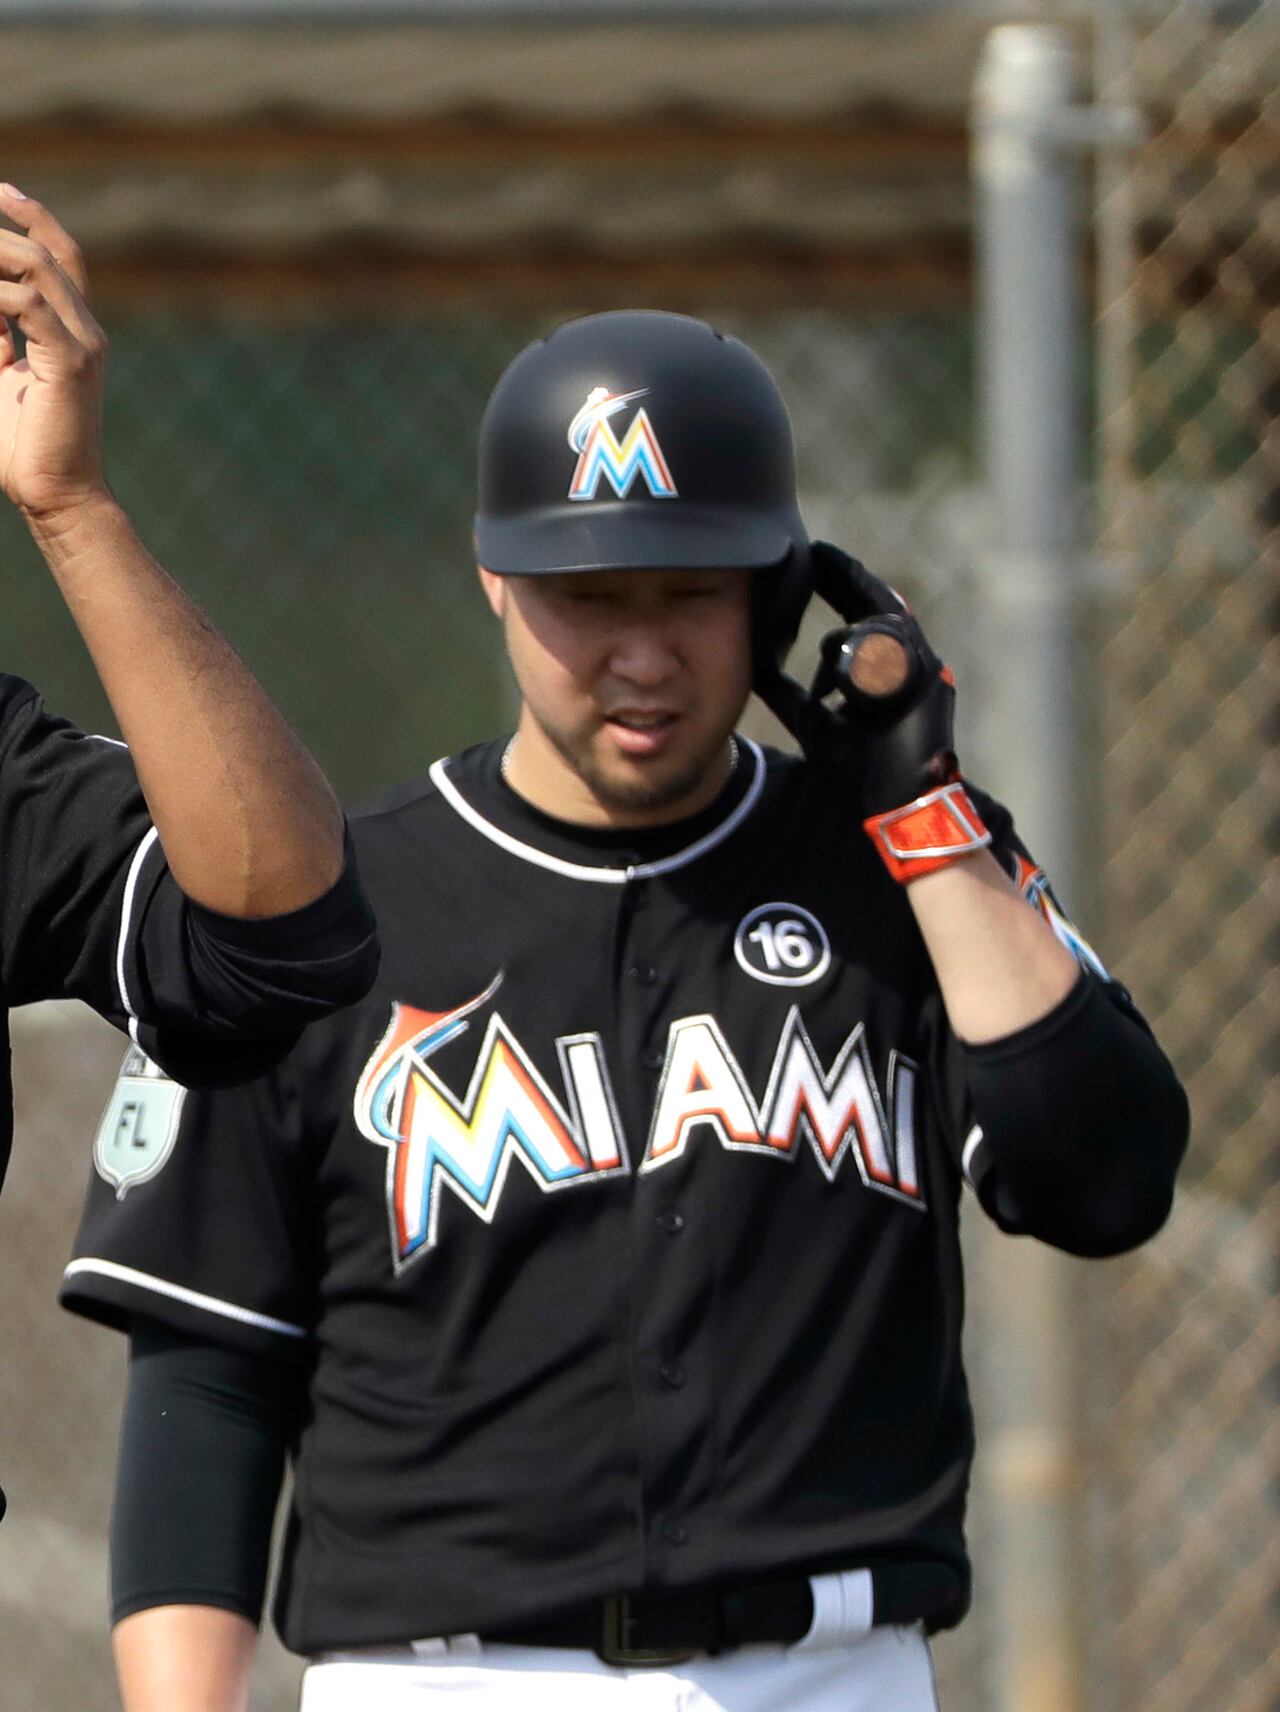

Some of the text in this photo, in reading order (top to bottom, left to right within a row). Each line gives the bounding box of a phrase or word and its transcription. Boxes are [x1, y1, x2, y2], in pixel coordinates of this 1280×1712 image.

[568, 406, 679, 501] M
[748, 919, 814, 969] 16
[113, 1101, 146, 1149] FL
[385, 1003, 928, 1278] MIAMI
